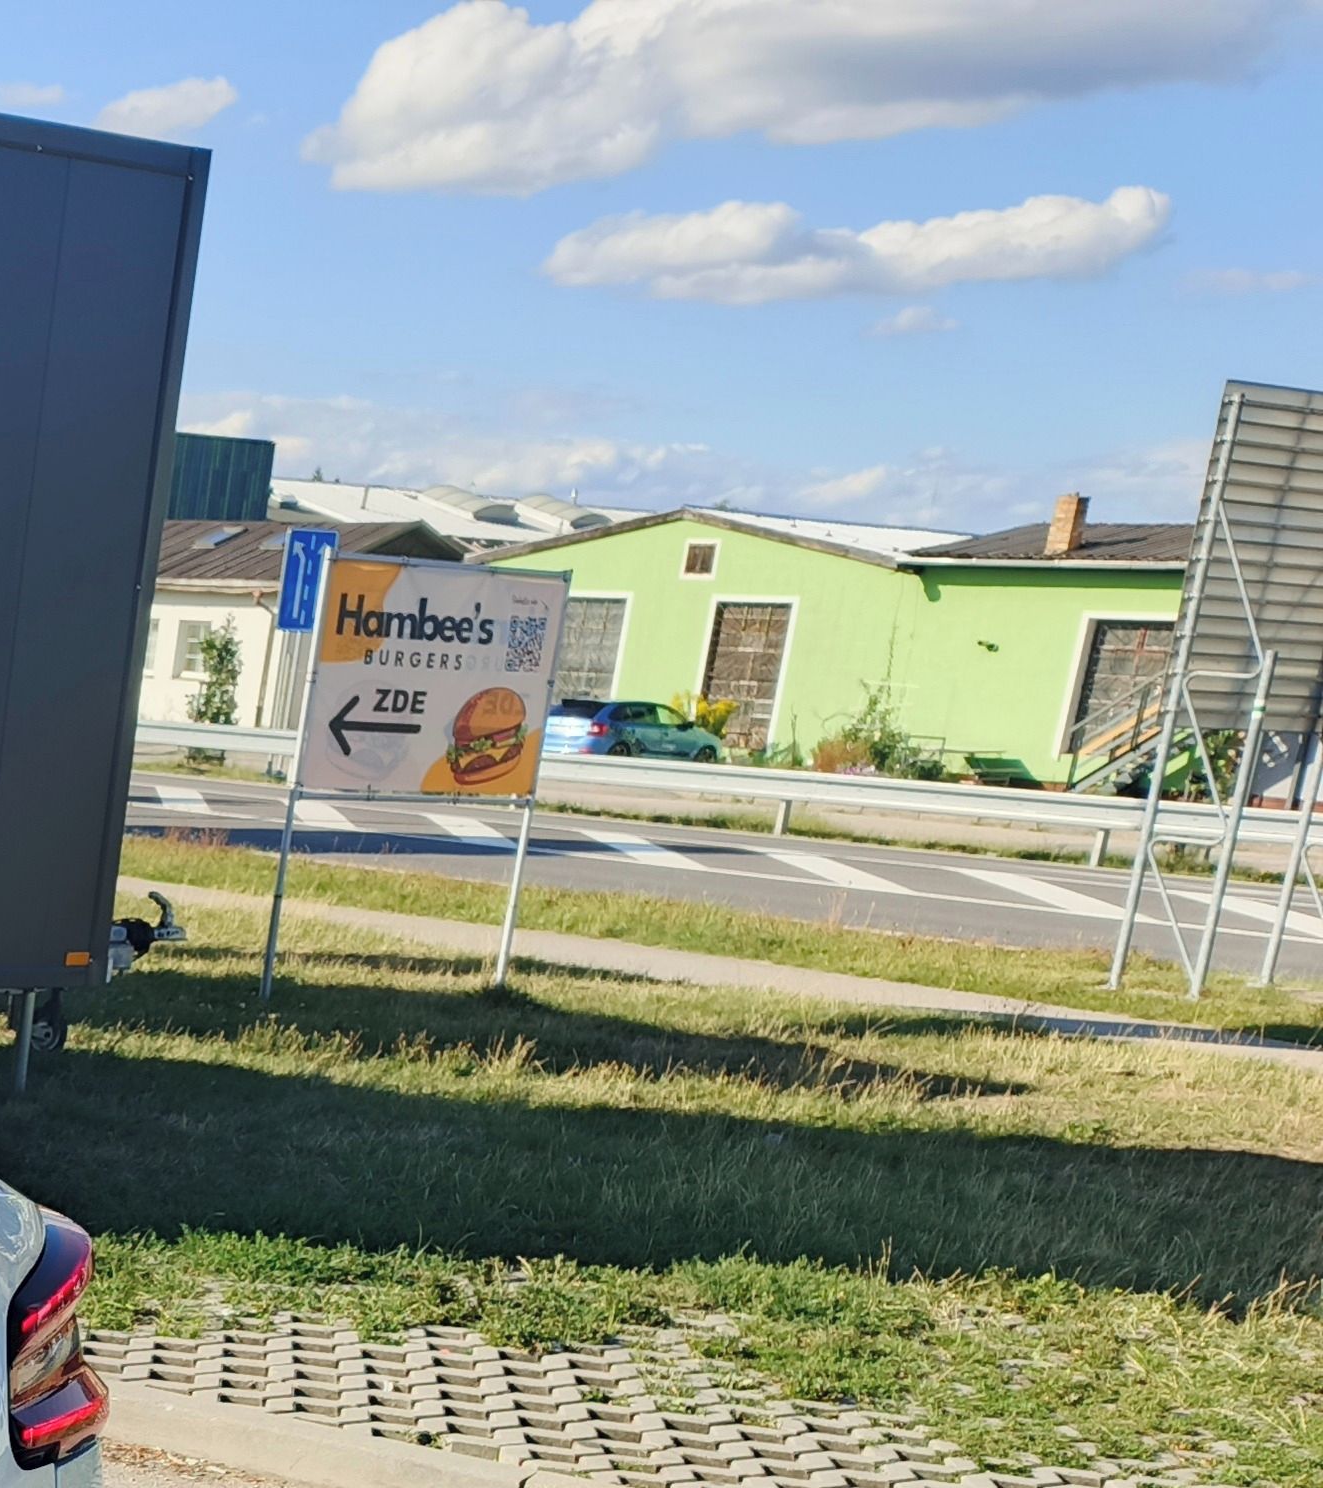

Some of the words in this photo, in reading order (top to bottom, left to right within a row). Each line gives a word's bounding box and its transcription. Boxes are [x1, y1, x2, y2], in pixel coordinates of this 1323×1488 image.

[336, 593, 494, 645] Hambee's
[364, 649, 463, 671] BURGERS
[373, 689, 427, 714] ZDE
